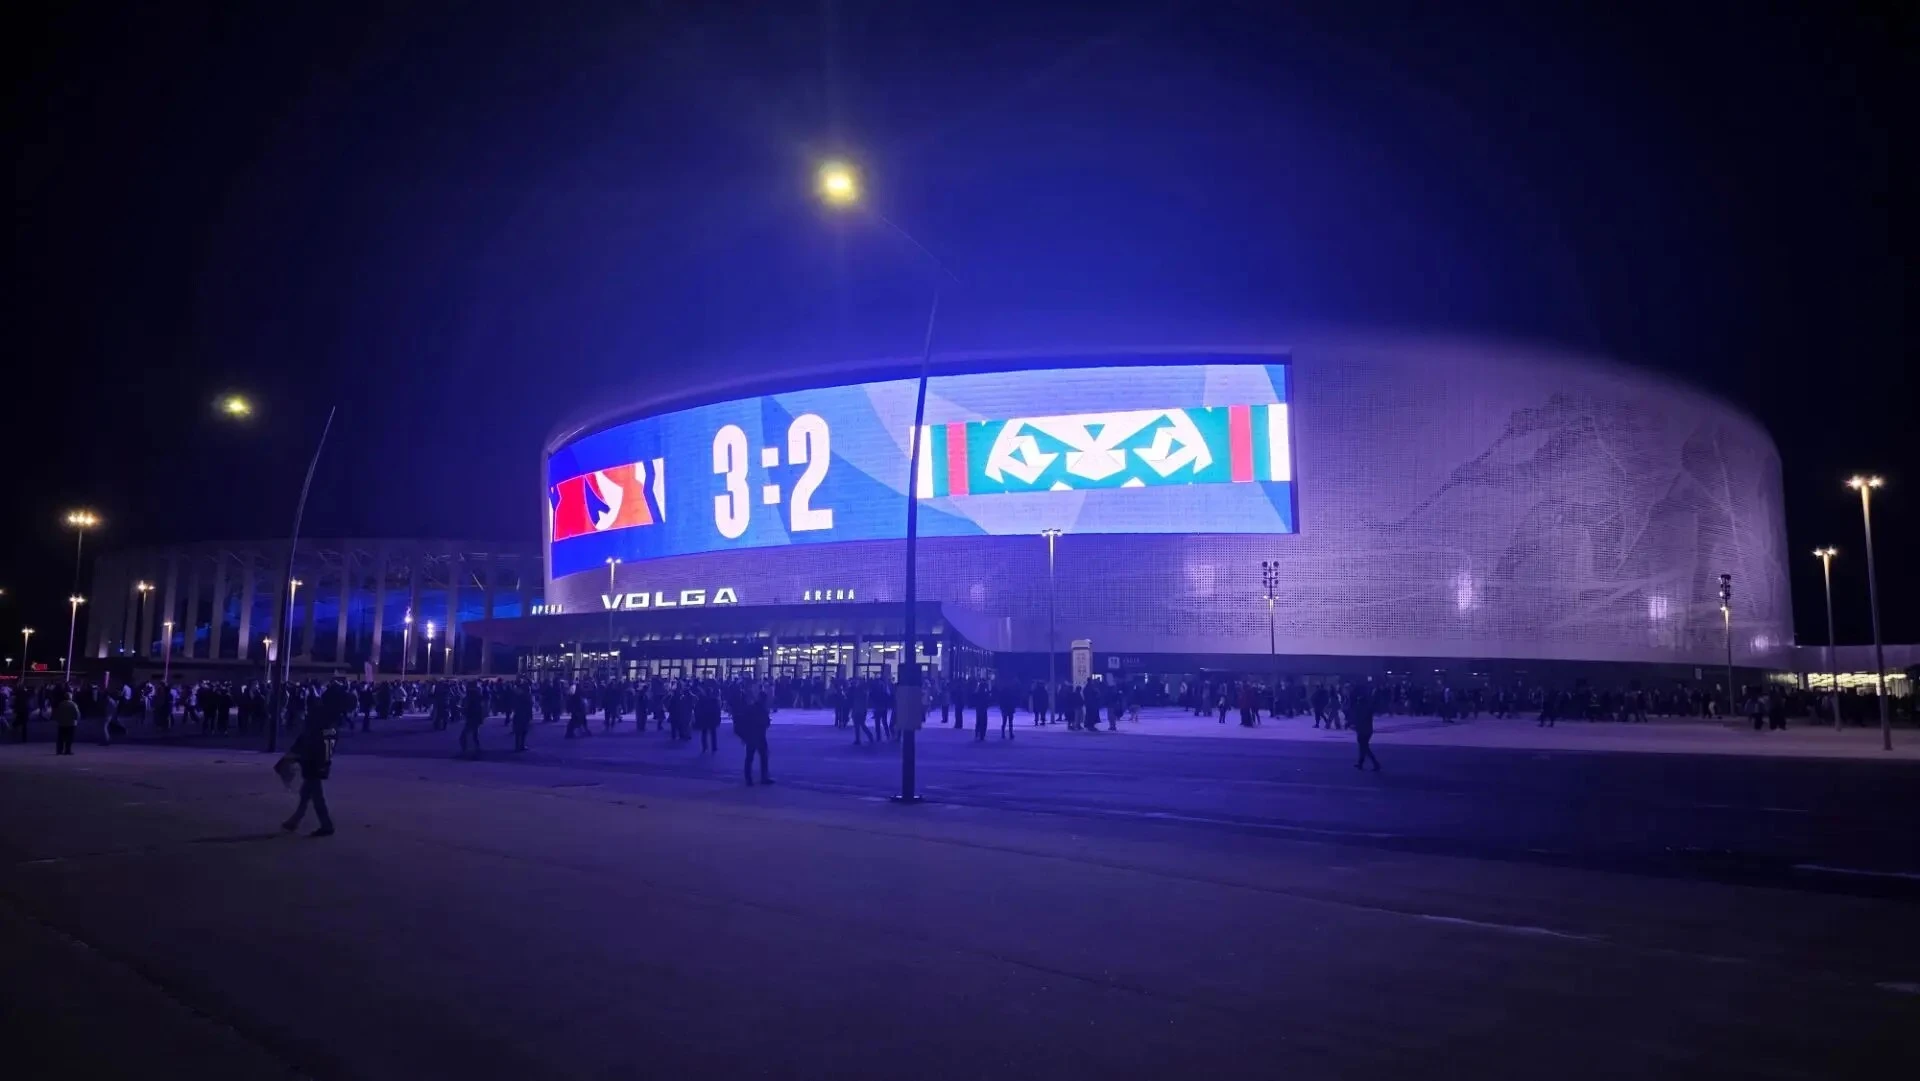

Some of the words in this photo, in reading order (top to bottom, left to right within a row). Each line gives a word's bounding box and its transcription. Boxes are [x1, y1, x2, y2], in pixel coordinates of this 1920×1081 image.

[713, 413, 834, 539] 3:2
[601, 587, 738, 609] VOLGA
[803, 589, 854, 601] ARENA
